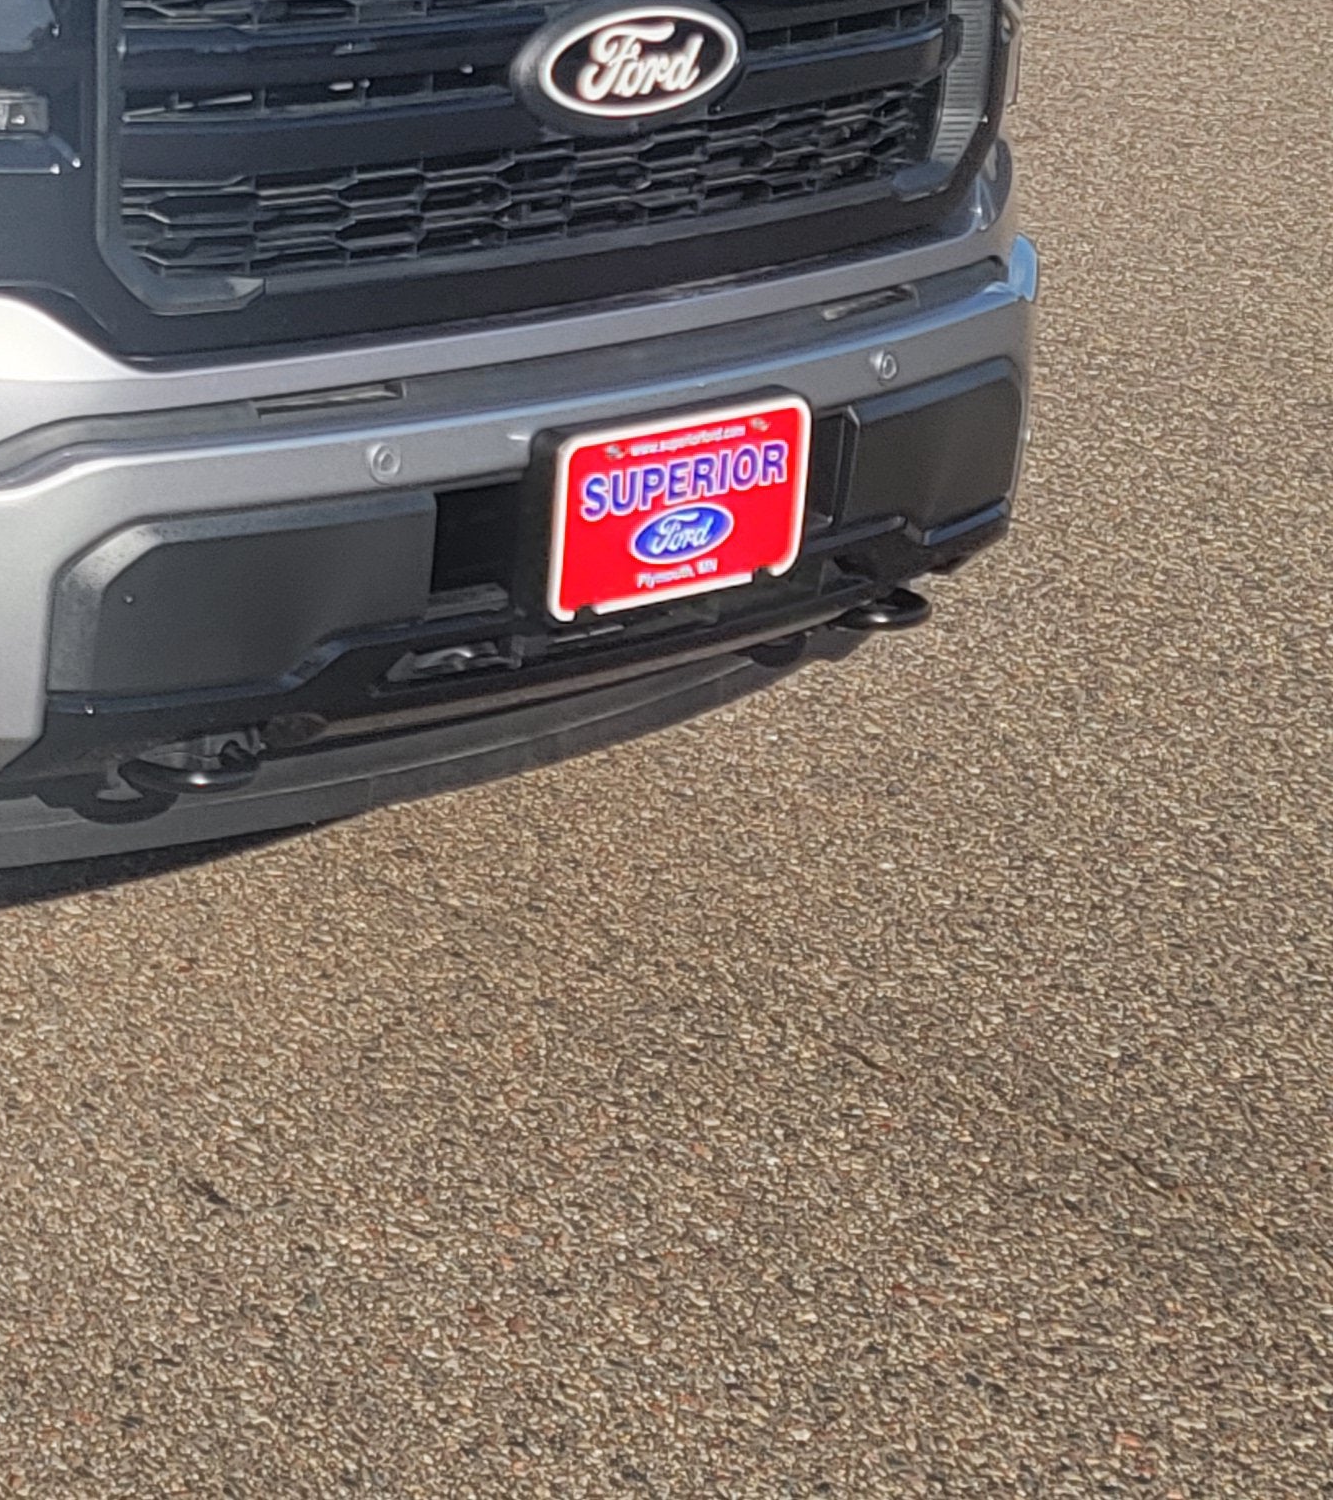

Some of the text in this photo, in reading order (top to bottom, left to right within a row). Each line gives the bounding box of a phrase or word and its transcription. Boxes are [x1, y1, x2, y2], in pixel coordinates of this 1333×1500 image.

[577, 21, 705, 102] Ford
[580, 440, 789, 522] SUPERIOR
[650, 511, 715, 556] Ford
